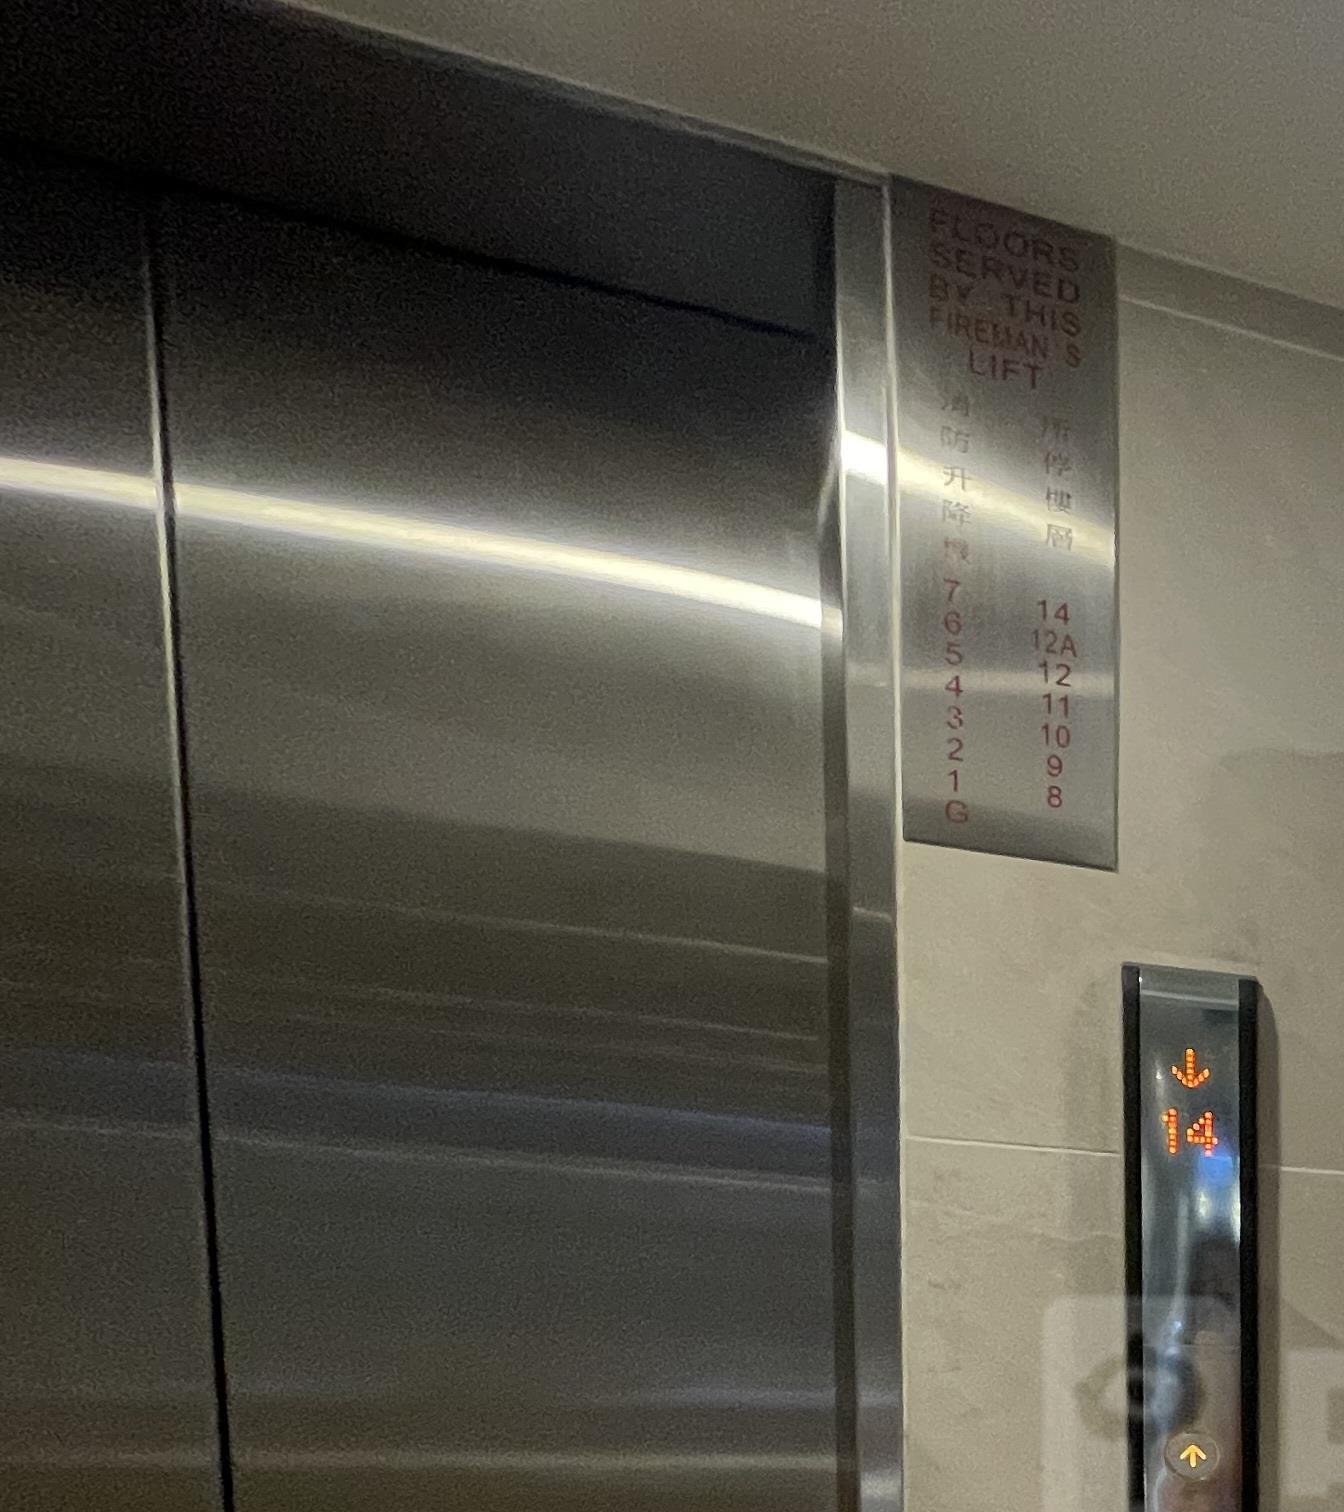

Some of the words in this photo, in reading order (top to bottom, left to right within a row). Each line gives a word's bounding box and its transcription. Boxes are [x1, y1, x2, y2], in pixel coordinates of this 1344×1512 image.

[930, 247, 1080, 303] SERVED
[1000, 294, 1082, 337] THIS
[968, 350, 1042, 389] LIFT
[944, 579, 961, 602] 7
[1037, 600, 1070, 626] 14
[944, 611, 962, 636] 6
[1030, 629, 1077, 658] 12A
[945, 642, 963, 666] 5
[1038, 661, 1071, 687] 12
[945, 675, 964, 697] 4
[1042, 693, 1069, 718] 11
[946, 706, 964, 730] 3
[1041, 723, 1070, 749] 10
[947, 738, 964, 762] 2
[1046, 754, 1063, 778] 9
[948, 769, 959, 792] 1
[1046, 786, 1063, 809] 8
[945, 800, 969, 824] G
[1161, 1108, 1218, 1157] 14
